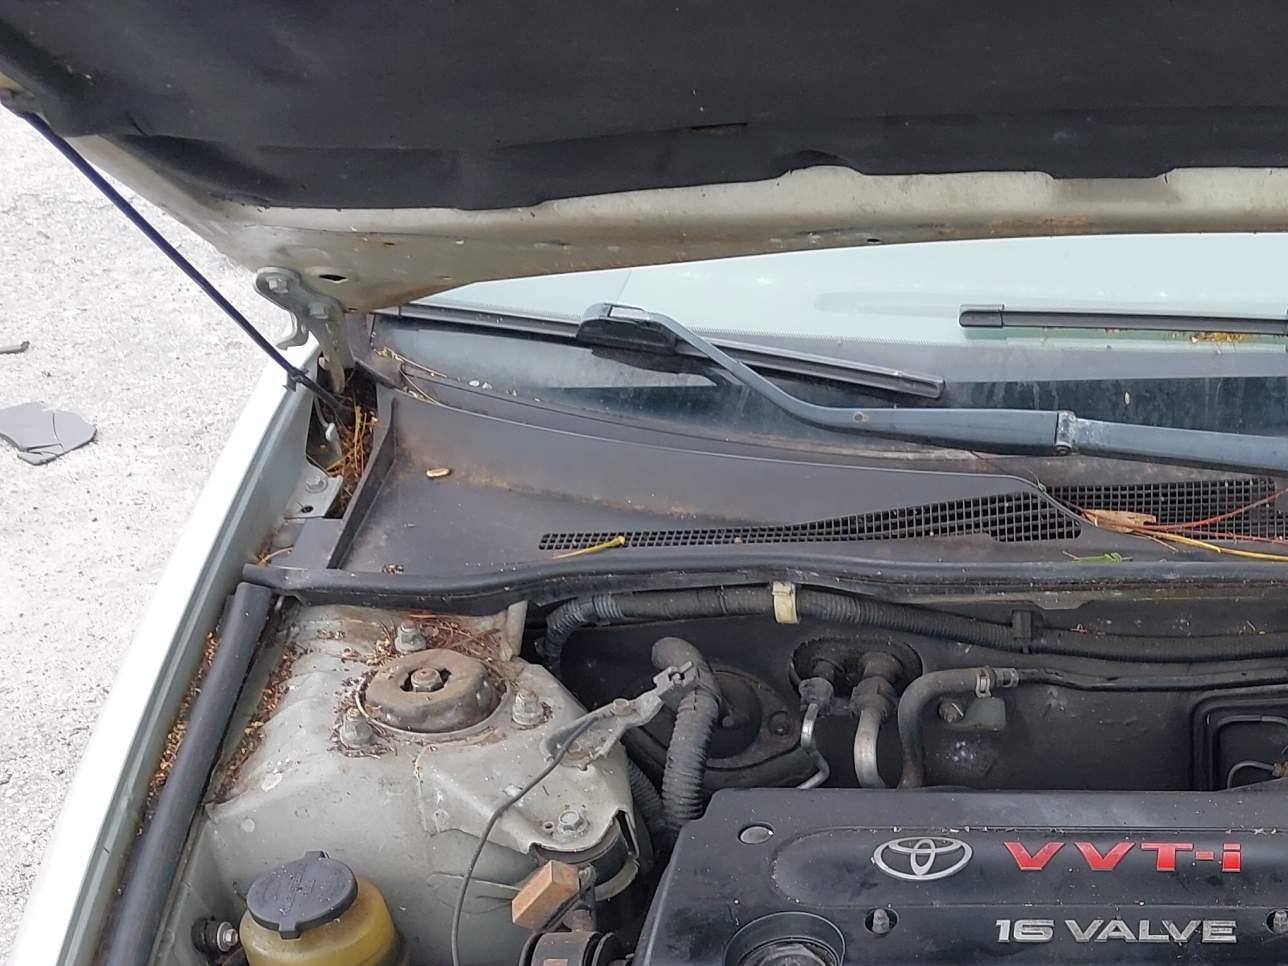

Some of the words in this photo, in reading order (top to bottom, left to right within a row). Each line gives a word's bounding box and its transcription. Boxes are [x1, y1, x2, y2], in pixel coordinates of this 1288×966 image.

[1004, 841, 1242, 873] VVT-i
[995, 918, 1054, 943] 16
[1065, 918, 1238, 943] VALVE
